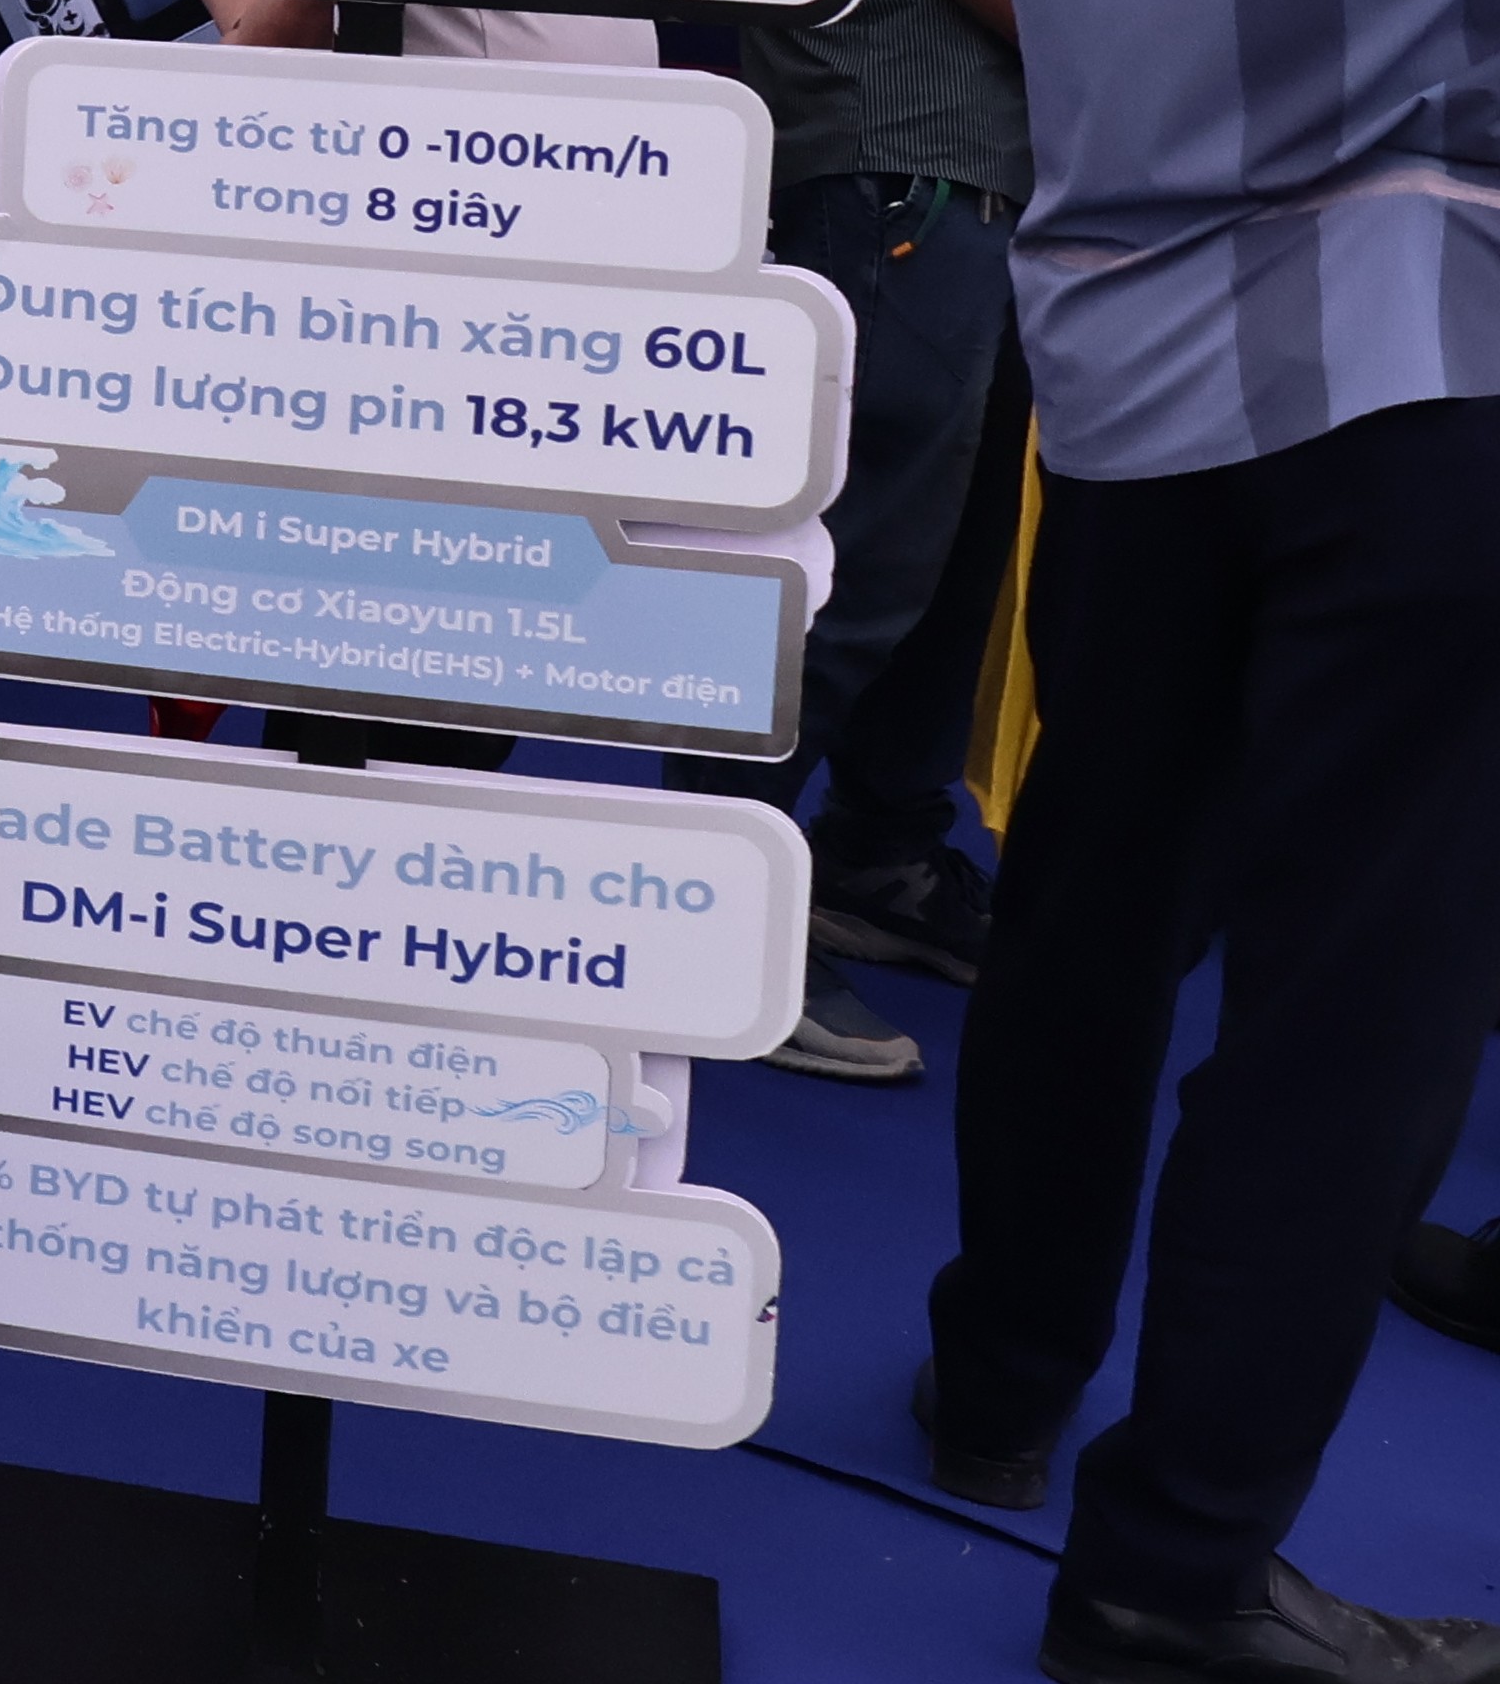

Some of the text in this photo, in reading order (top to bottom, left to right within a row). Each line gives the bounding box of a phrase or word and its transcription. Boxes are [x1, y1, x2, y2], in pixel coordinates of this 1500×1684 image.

[152, 365, 329, 432] lượng
[349, 383, 447, 435] pin
[465, 395, 583, 449] 18,3
[601, 404, 754, 459] kWh
[22, 880, 628, 989] DM-i Super Hybrid
[63, 999, 499, 1078] EV chế độ thuần điện
[137, 1297, 449, 1374] khiển của xe
